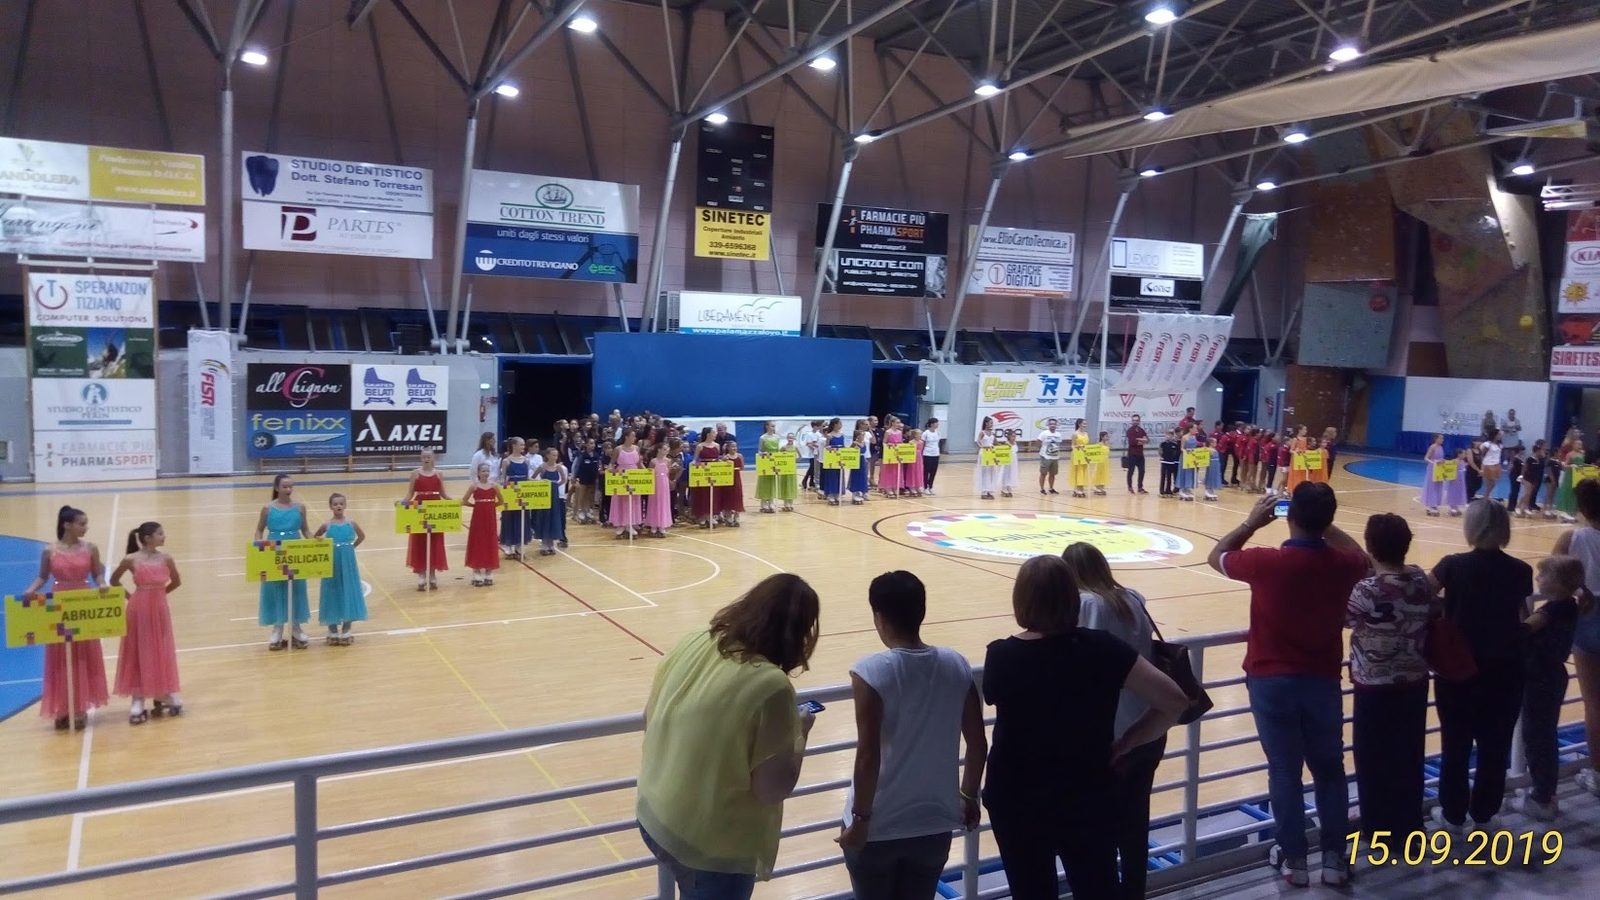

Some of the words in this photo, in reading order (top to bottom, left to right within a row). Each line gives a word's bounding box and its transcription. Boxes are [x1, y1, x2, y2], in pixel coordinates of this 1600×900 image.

[291, 159, 342, 173] STUDIO
[346, 165, 423, 181] DENTISTICO
[324, 174, 369, 187] Stefano
[373, 179, 423, 192] Torresan
[500, 206, 555, 221] COTTON
[559, 211, 606, 225] TREND
[702, 209, 765, 226] SINETEC
[860, 210, 907, 224] FARMACIE
[328, 218, 394, 233] PARTES
[860, 225, 924, 238] PHARMASPORT
[497, 229, 517, 238] uniti
[518, 230, 540, 241] dagli
[541, 233, 566, 242] stessi
[567, 234, 590, 243] valori
[1006, 264, 1042, 275] GRAFICHE
[75, 280, 147, 296] SPERANZON
[76, 298, 122, 311] TIZIANO
[37, 314, 89, 322] COMPUTER
[95, 315, 148, 323] SOLUTIONS
[364, 389, 394, 397] BELATI
[407, 389, 436, 397] BELATI
[251, 413, 346, 431] fenixx
[388, 424, 443, 441] AXEL
[62, 455, 154, 467] PHARMASPORT
[516, 490, 549, 499] CAMPANIA
[423, 512, 460, 521] CALABRIA
[275, 553, 330, 565] BASILICATA
[61, 606, 122, 622] ABRUZZO
